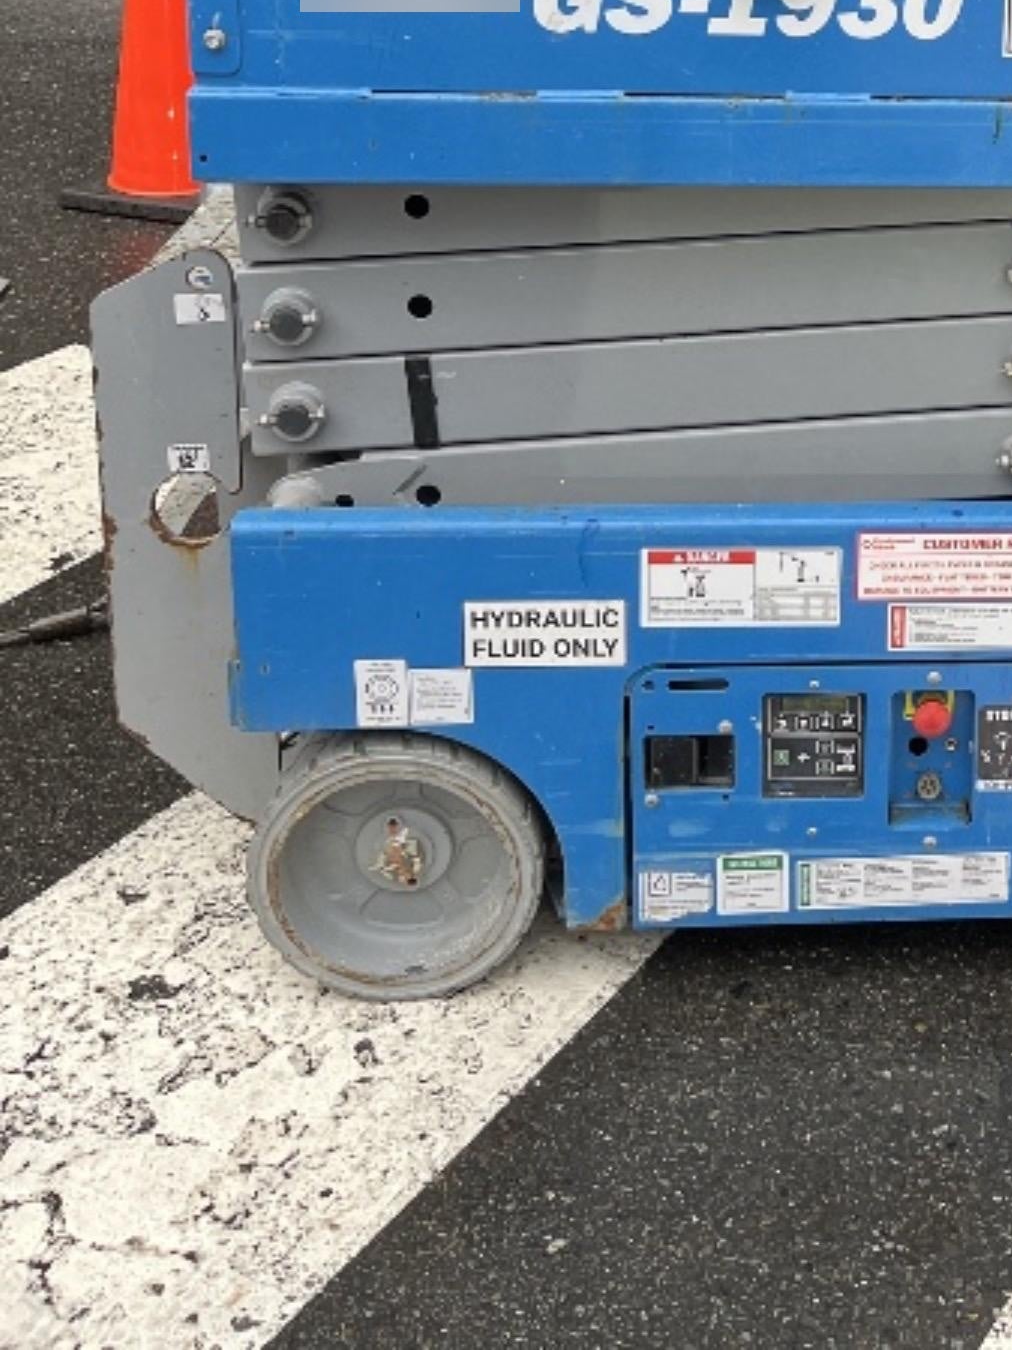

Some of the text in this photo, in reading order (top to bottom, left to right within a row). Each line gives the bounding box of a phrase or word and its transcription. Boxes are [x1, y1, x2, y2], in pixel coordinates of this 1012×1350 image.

[470, 609, 620, 629] HYDRAULIC
[472, 637, 619, 658] FLUID ONLY
